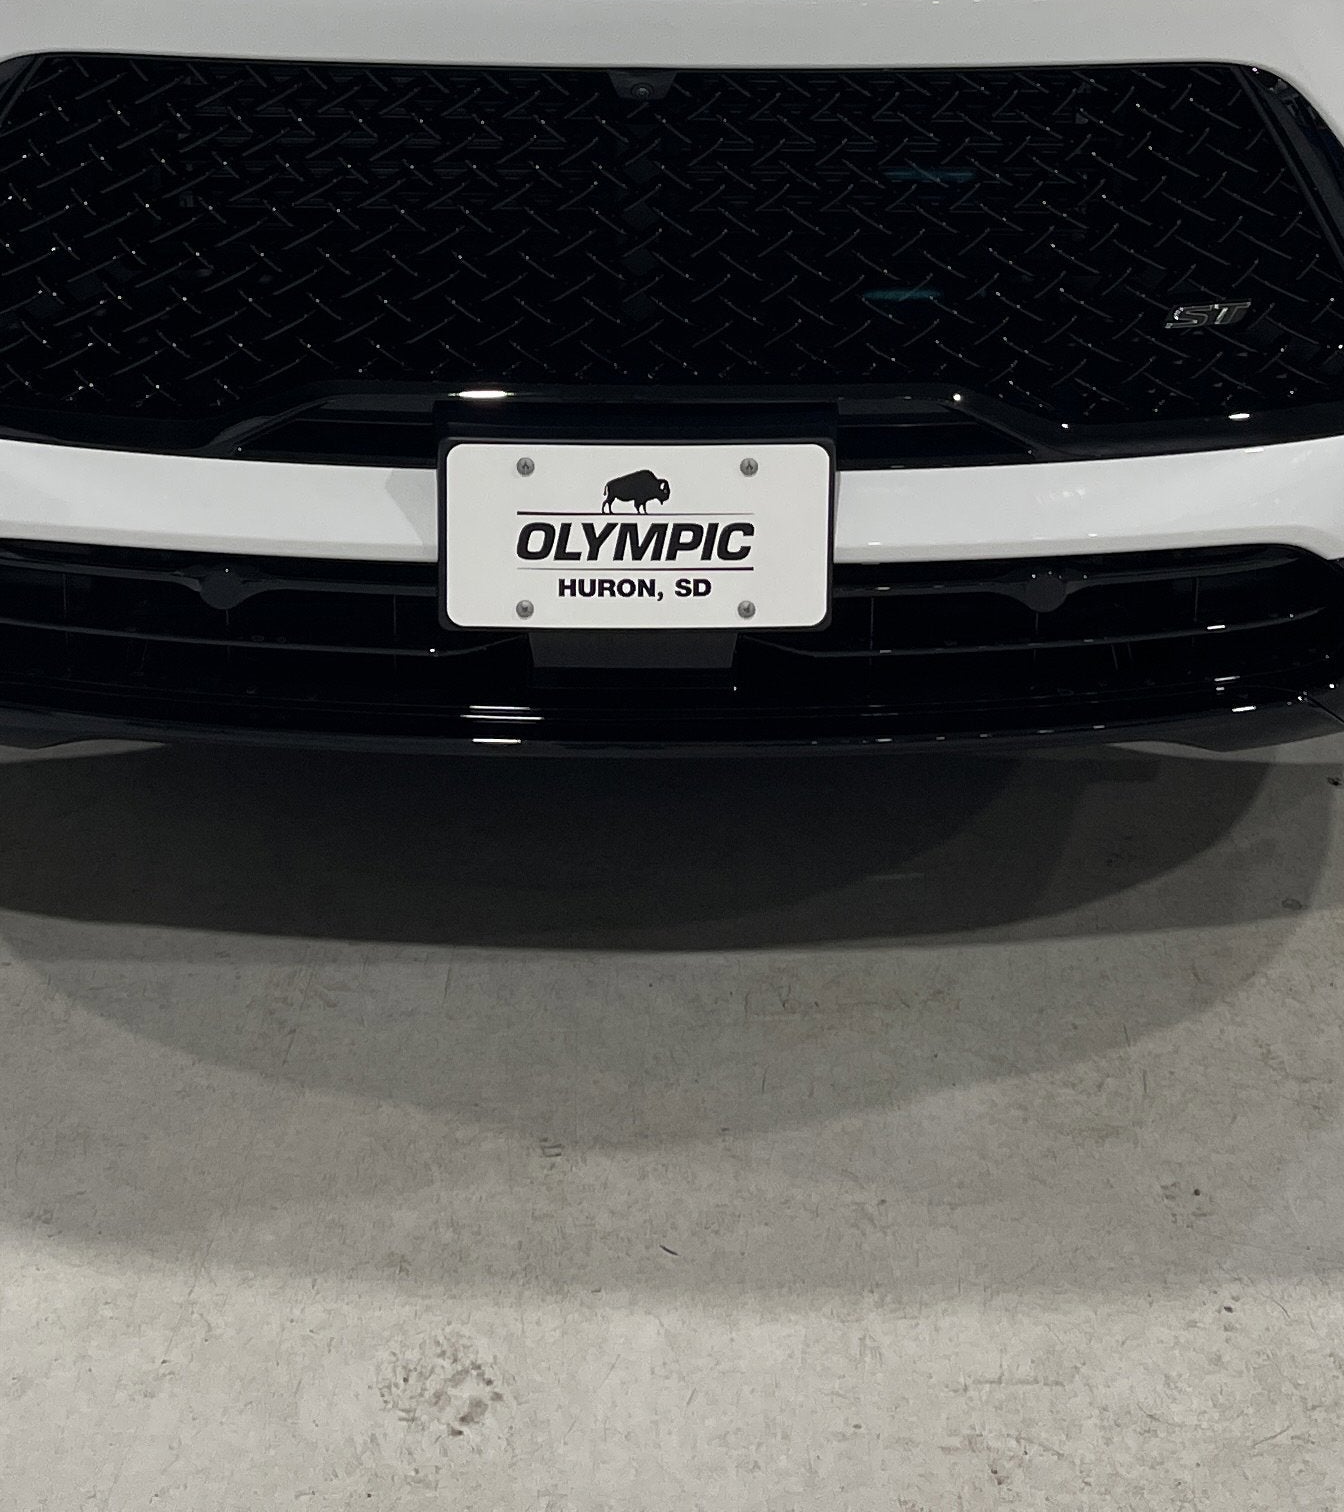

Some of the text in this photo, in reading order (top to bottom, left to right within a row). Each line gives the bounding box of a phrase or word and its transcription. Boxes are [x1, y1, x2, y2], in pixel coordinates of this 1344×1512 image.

[1164, 301, 1251, 329] ST
[516, 522, 755, 561] OLYMPIC
[558, 578, 712, 601] HURON, SD
